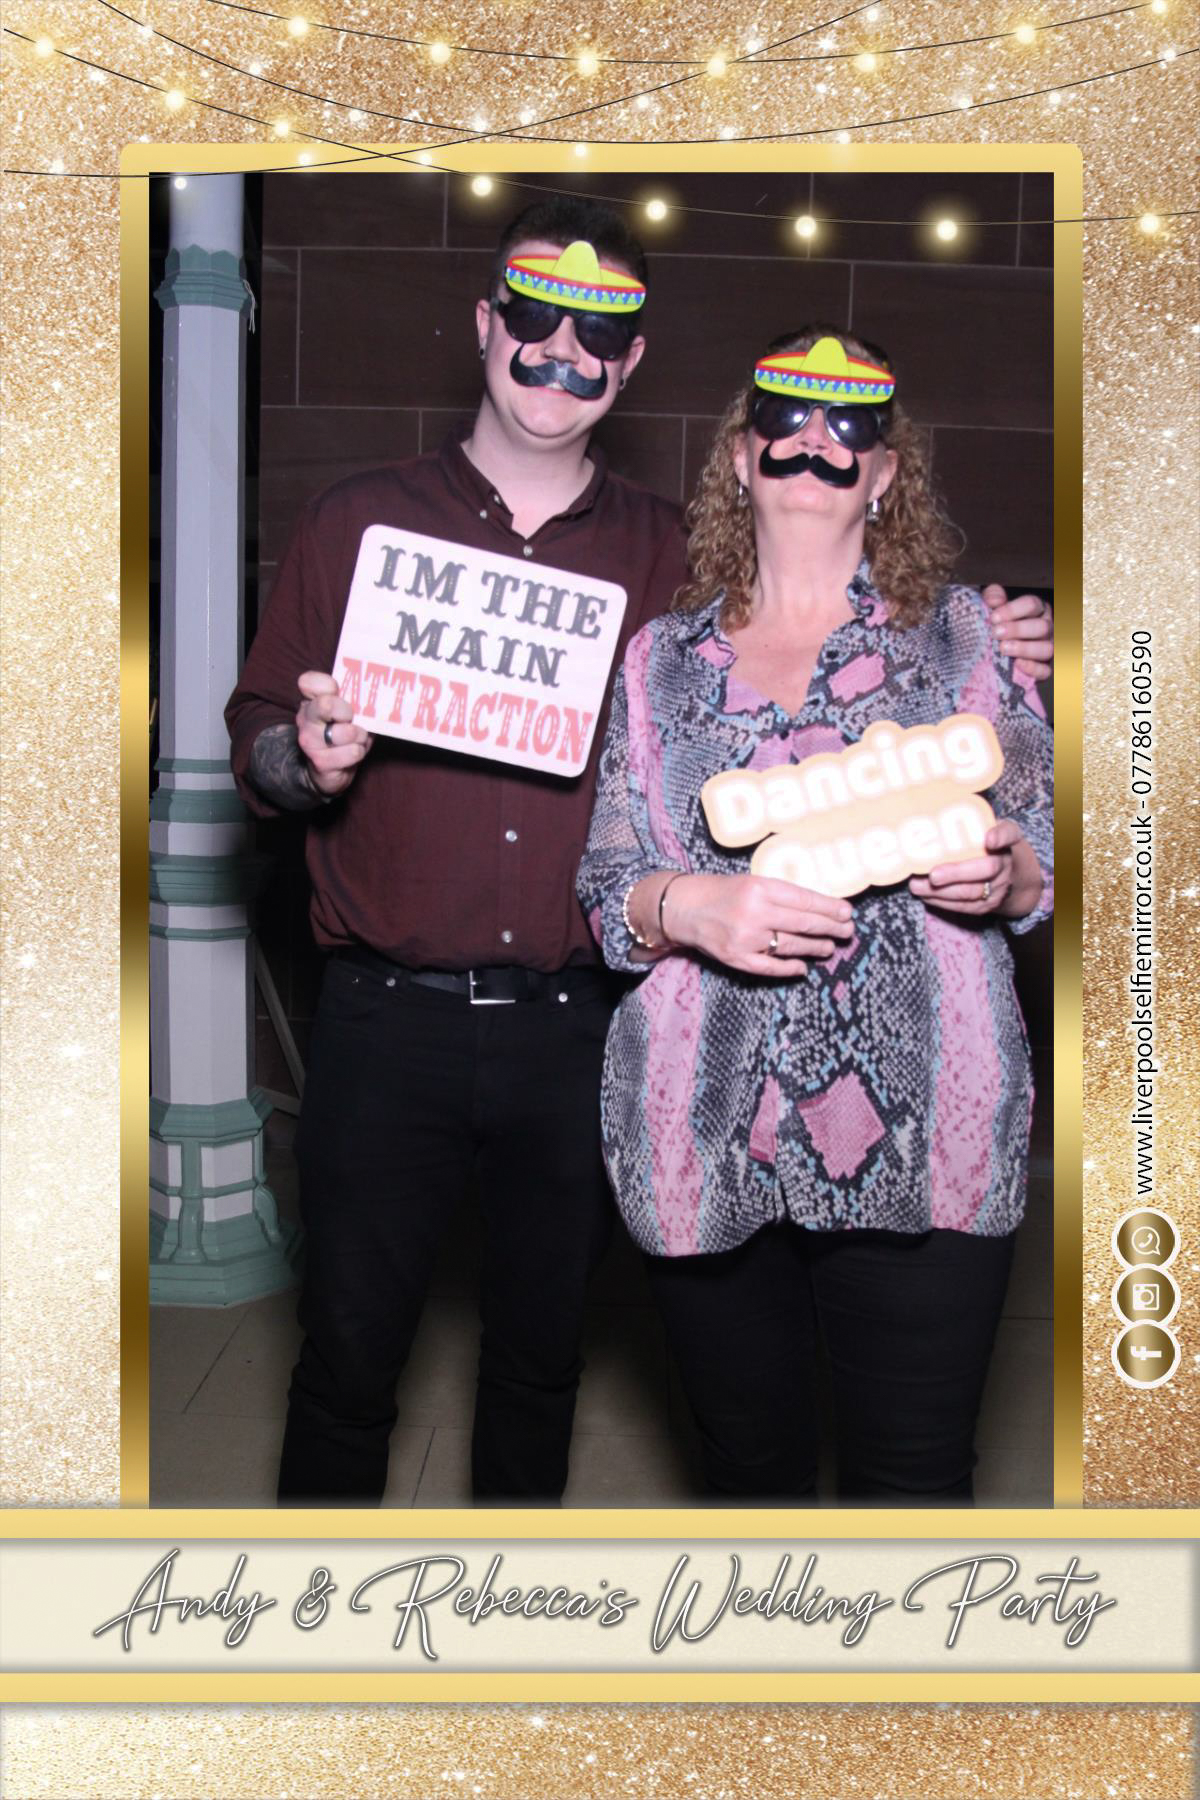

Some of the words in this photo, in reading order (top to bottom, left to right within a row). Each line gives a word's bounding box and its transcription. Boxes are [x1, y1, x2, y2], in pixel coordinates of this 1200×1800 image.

[374, 545, 467, 606] IM
[481, 570, 608, 640] THE
[389, 611, 567, 688] MAIN
[339, 657, 593, 764] ATTRACTION
[713, 724, 991, 837] Dancing
